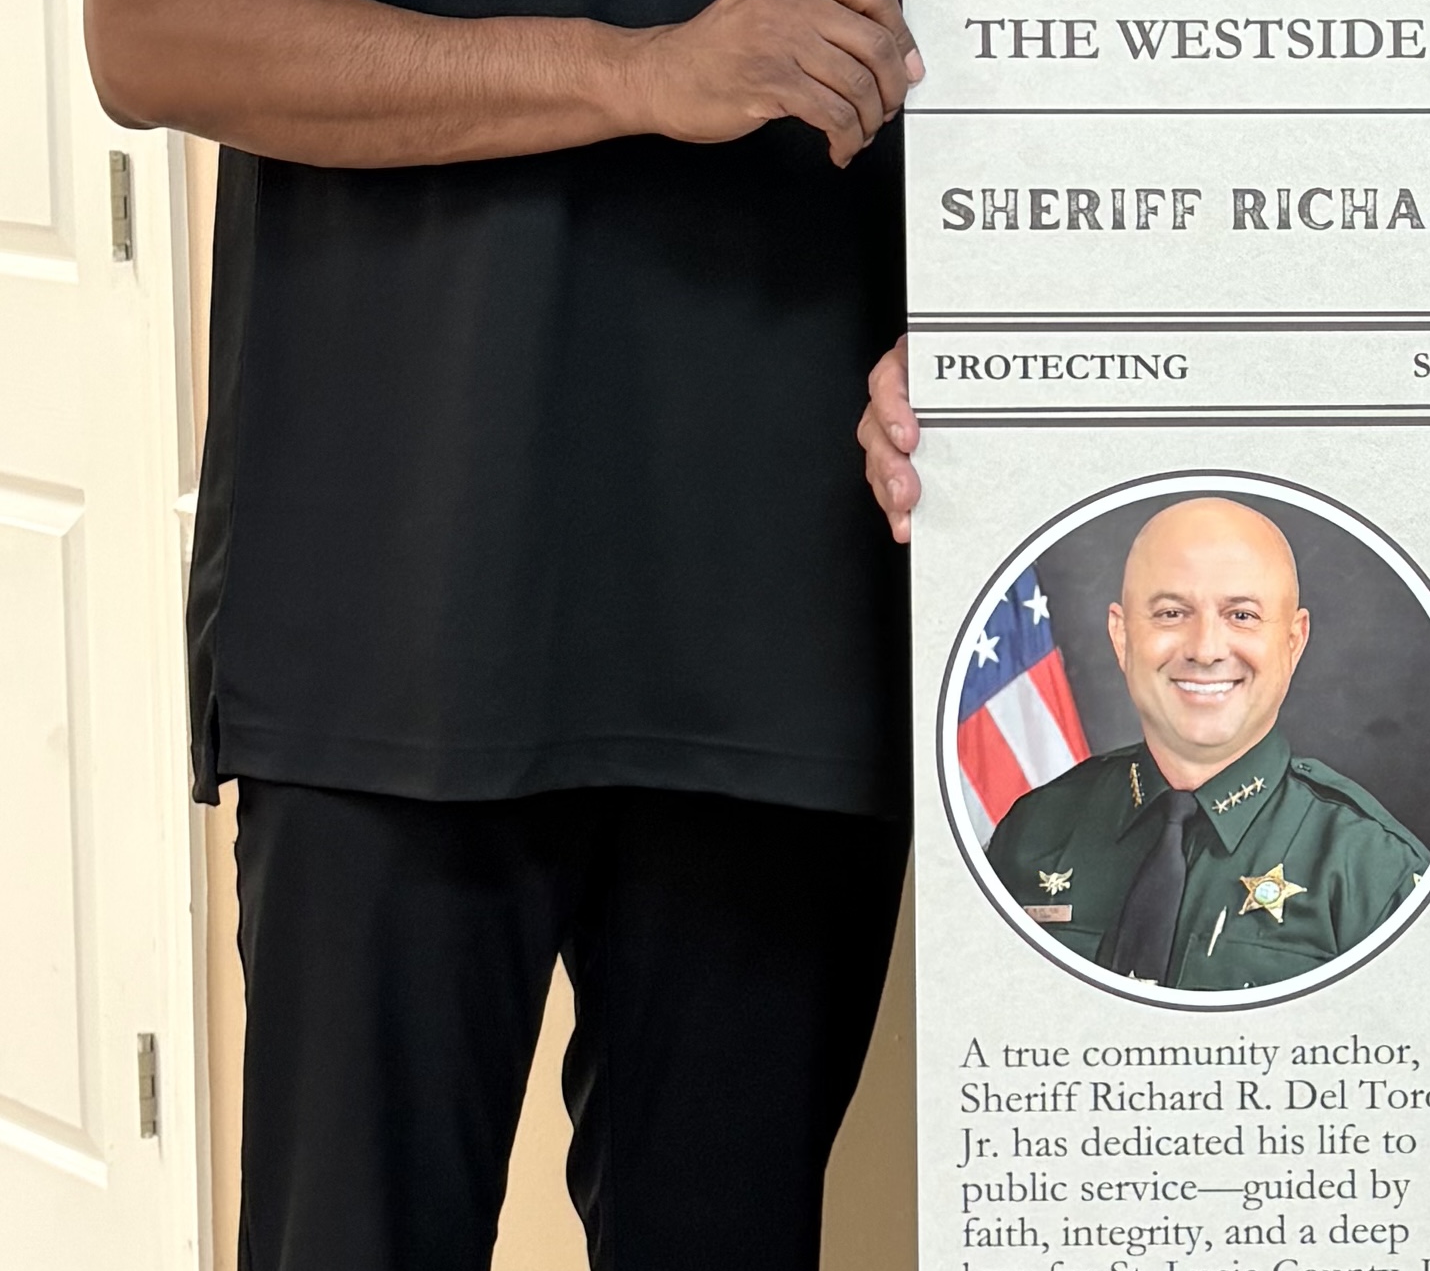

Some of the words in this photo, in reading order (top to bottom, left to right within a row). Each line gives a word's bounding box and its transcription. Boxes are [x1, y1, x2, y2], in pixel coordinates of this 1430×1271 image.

[965, 18, 1099, 58] THE
[1116, 18, 1426, 59] WESTSIDE
[942, 188, 1201, 230] SHERIFF
[935, 355, 1188, 379] PROTECTING
[961, 1038, 989, 1067] A
[1004, 1045, 1069, 1067] true
[1083, 1036, 1279, 1075] community
[1292, 1035, 1419, 1071] anchor,
[962, 1082, 1081, 1112] Sheriff
[1091, 1081, 1222, 1111] Richard
[1237, 1081, 1271, 1110] R.
[1286, 1080, 1347, 1109] Del
[957, 1129, 997, 1168] Jr.
[1013, 1127, 1067, 1156] has
[1082, 1125, 1244, 1156] dedicated
[1258, 1125, 1304, 1154] his
[1319, 1124, 1369, 1154] life
[1383, 1132, 1416, 1153] to
[962, 1172, 1066, 1213] public
[1082, 1169, 1357, 1210] service—guided
[1370, 1169, 1410, 1209] by
[964, 1217, 1049, 1253] faith,
[1063, 1216, 1212, 1256] integrity,
[1226, 1215, 1286, 1244] and
[1300, 1225, 1316, 1244] a
[1329, 1214, 1408, 1254] deep
